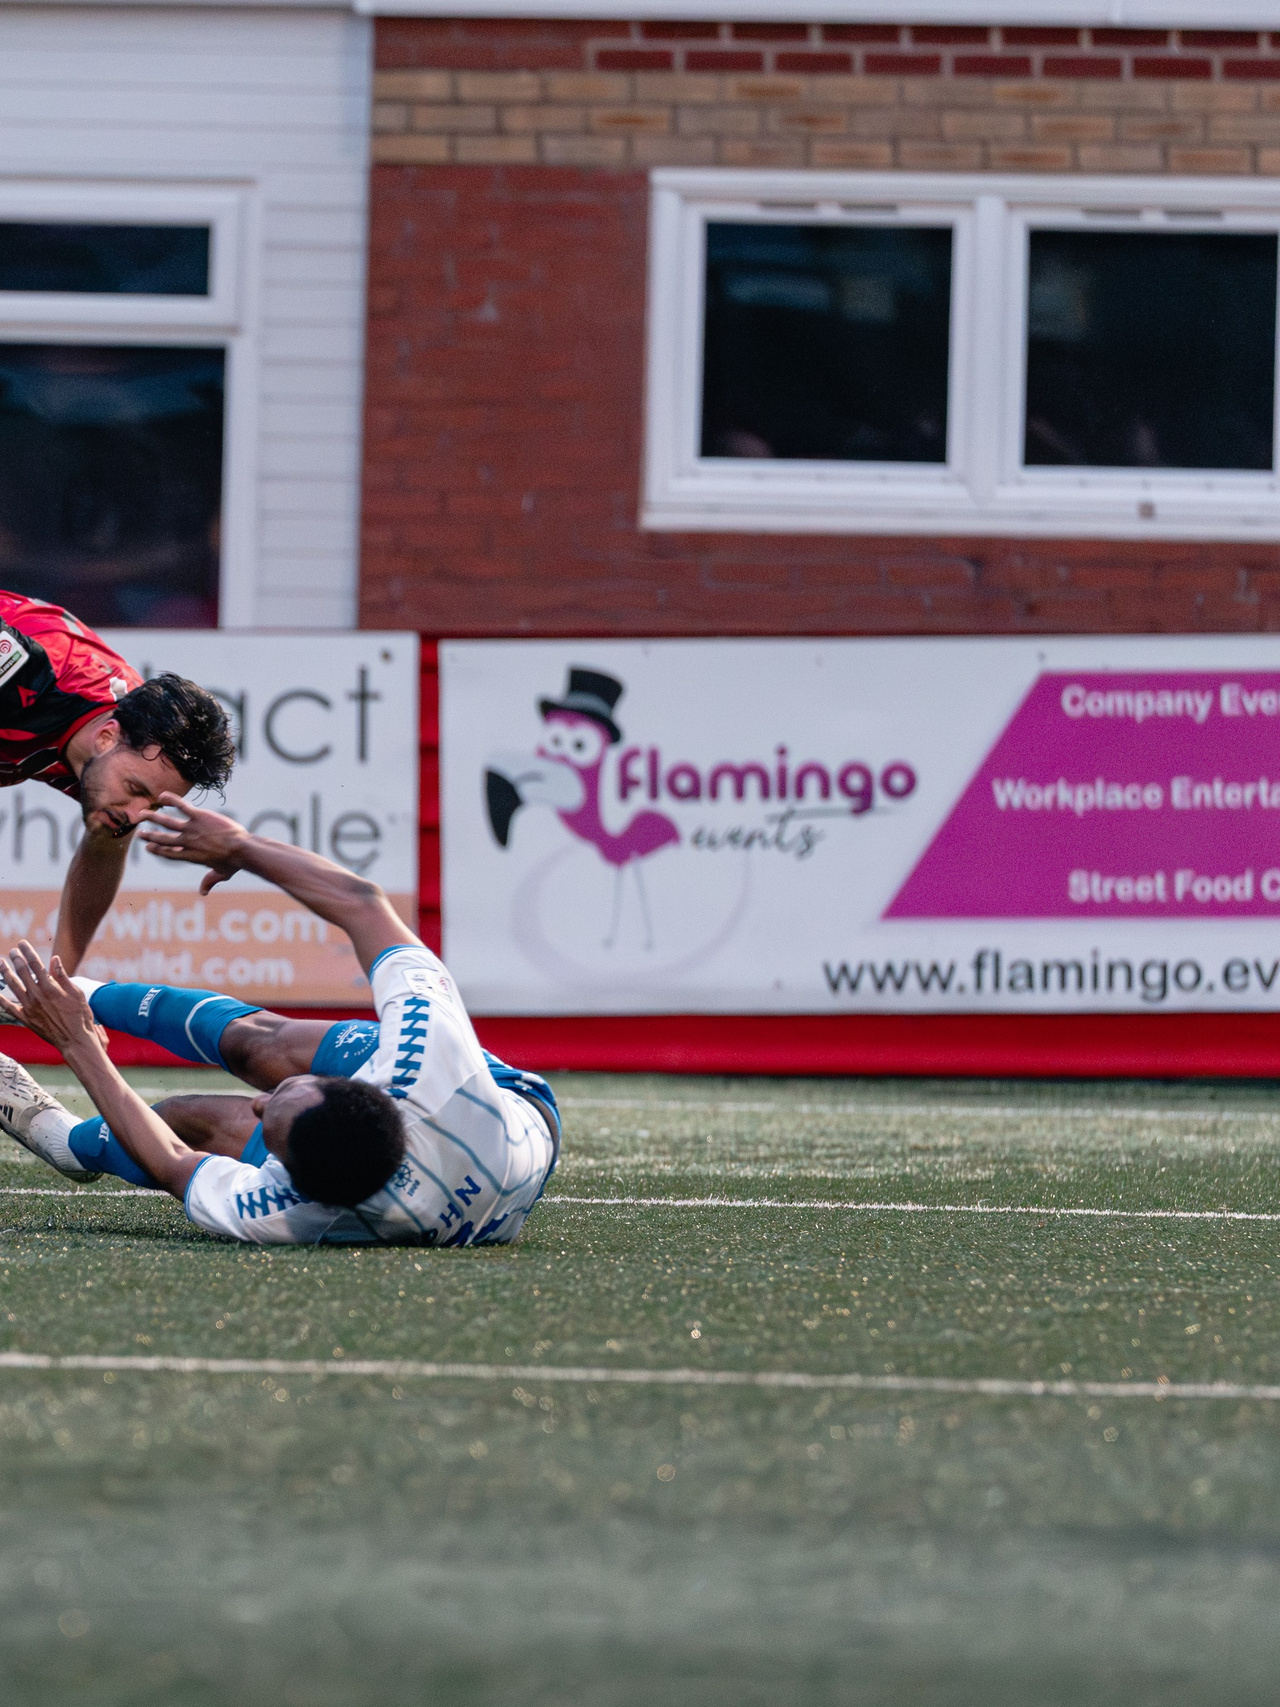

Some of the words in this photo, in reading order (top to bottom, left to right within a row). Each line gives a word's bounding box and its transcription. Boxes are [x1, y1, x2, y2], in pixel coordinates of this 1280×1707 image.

[1060, 683, 1214, 726] Company
[619, 746, 917, 816] flamingo
[992, 776, 1165, 817] Workplace
[691, 806, 828, 861] events
[1068, 868, 1167, 903] Street
[1174, 868, 1255, 902] Food
